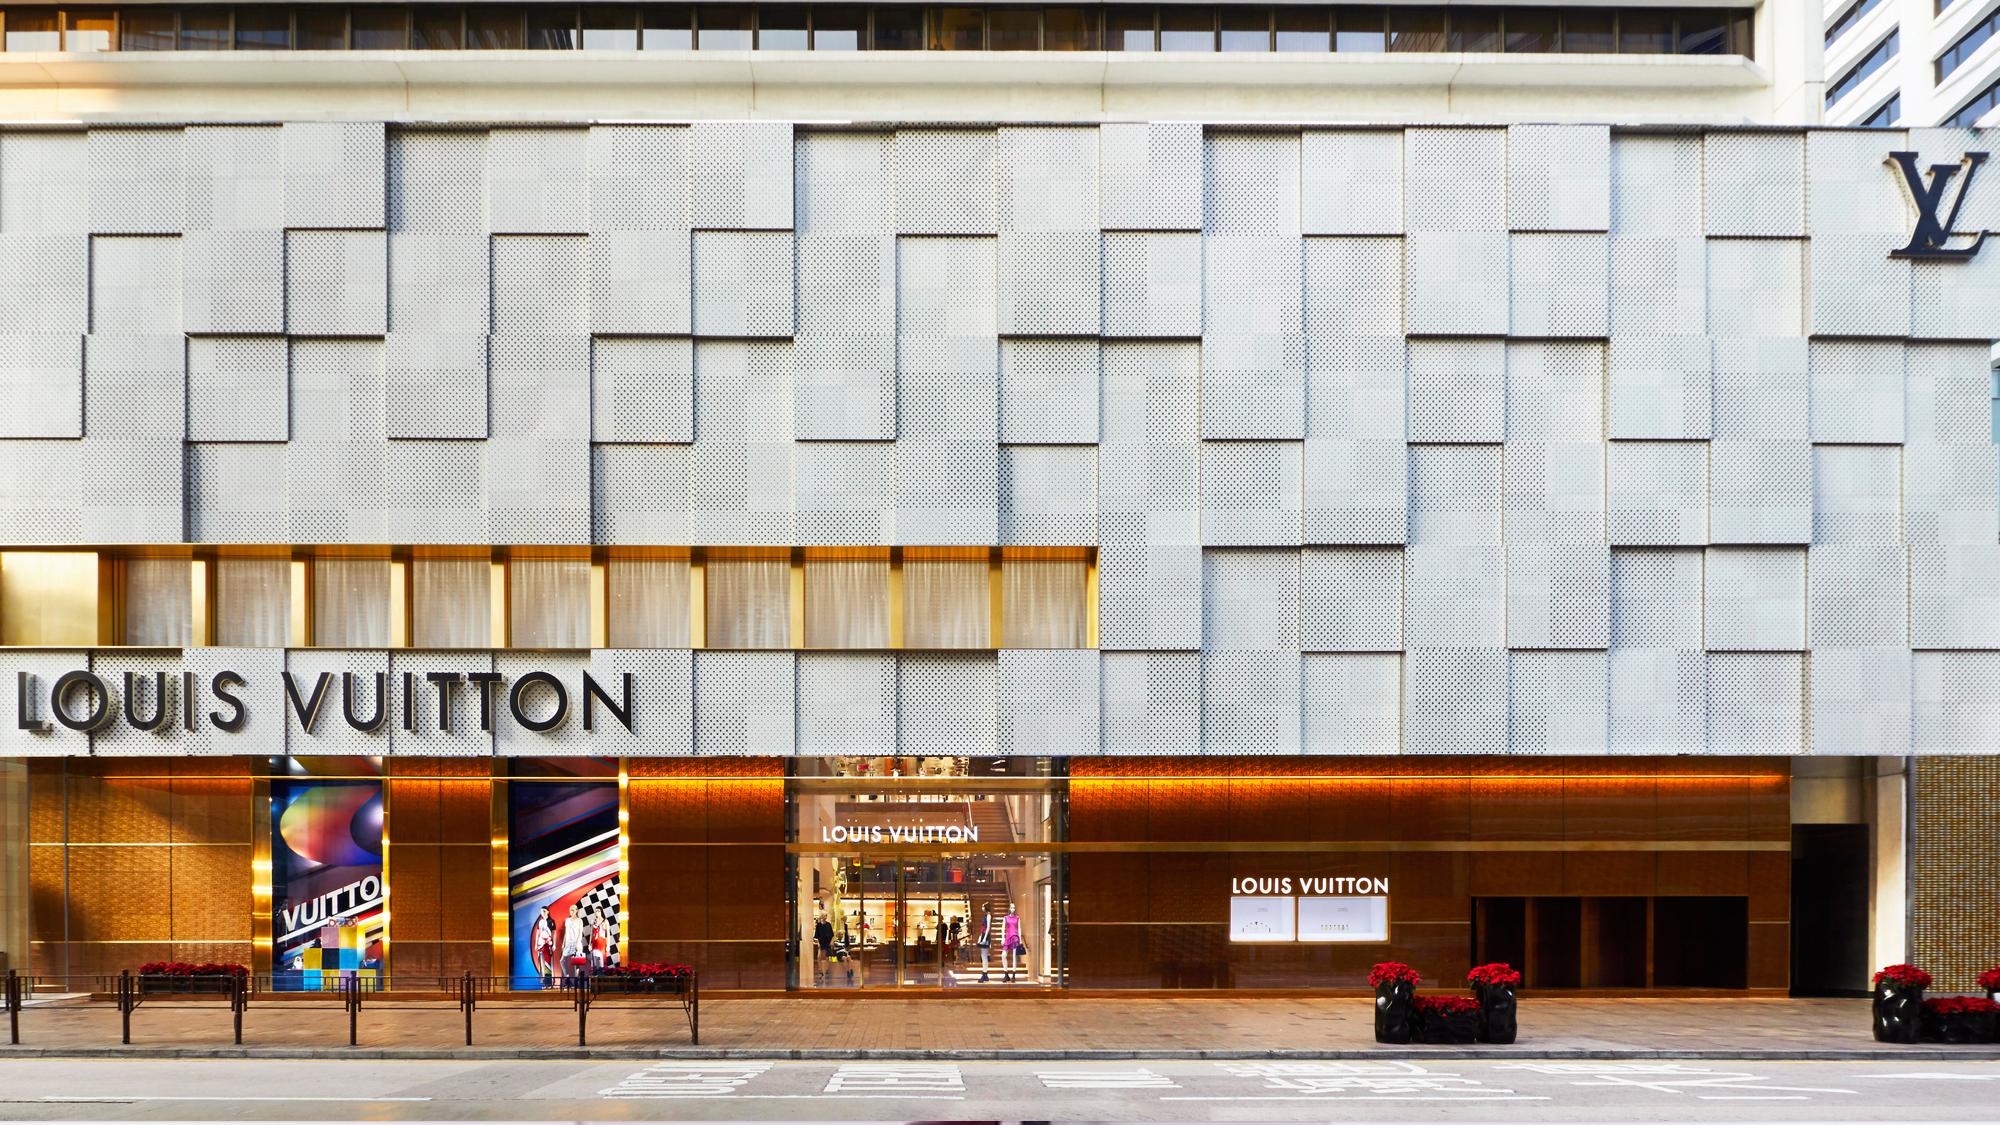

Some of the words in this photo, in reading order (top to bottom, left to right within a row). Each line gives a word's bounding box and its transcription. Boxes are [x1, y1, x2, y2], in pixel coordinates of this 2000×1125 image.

[17, 669, 247, 732] LOUIS
[280, 669, 634, 734] VUITTON
[822, 825, 881, 843] LOUIS
[888, 825, 979, 843] VUITTON
[282, 871, 384, 932] VUITTO
[1232, 877, 1292, 894] LOUIS
[1299, 877, 1389, 894] VUITTON
